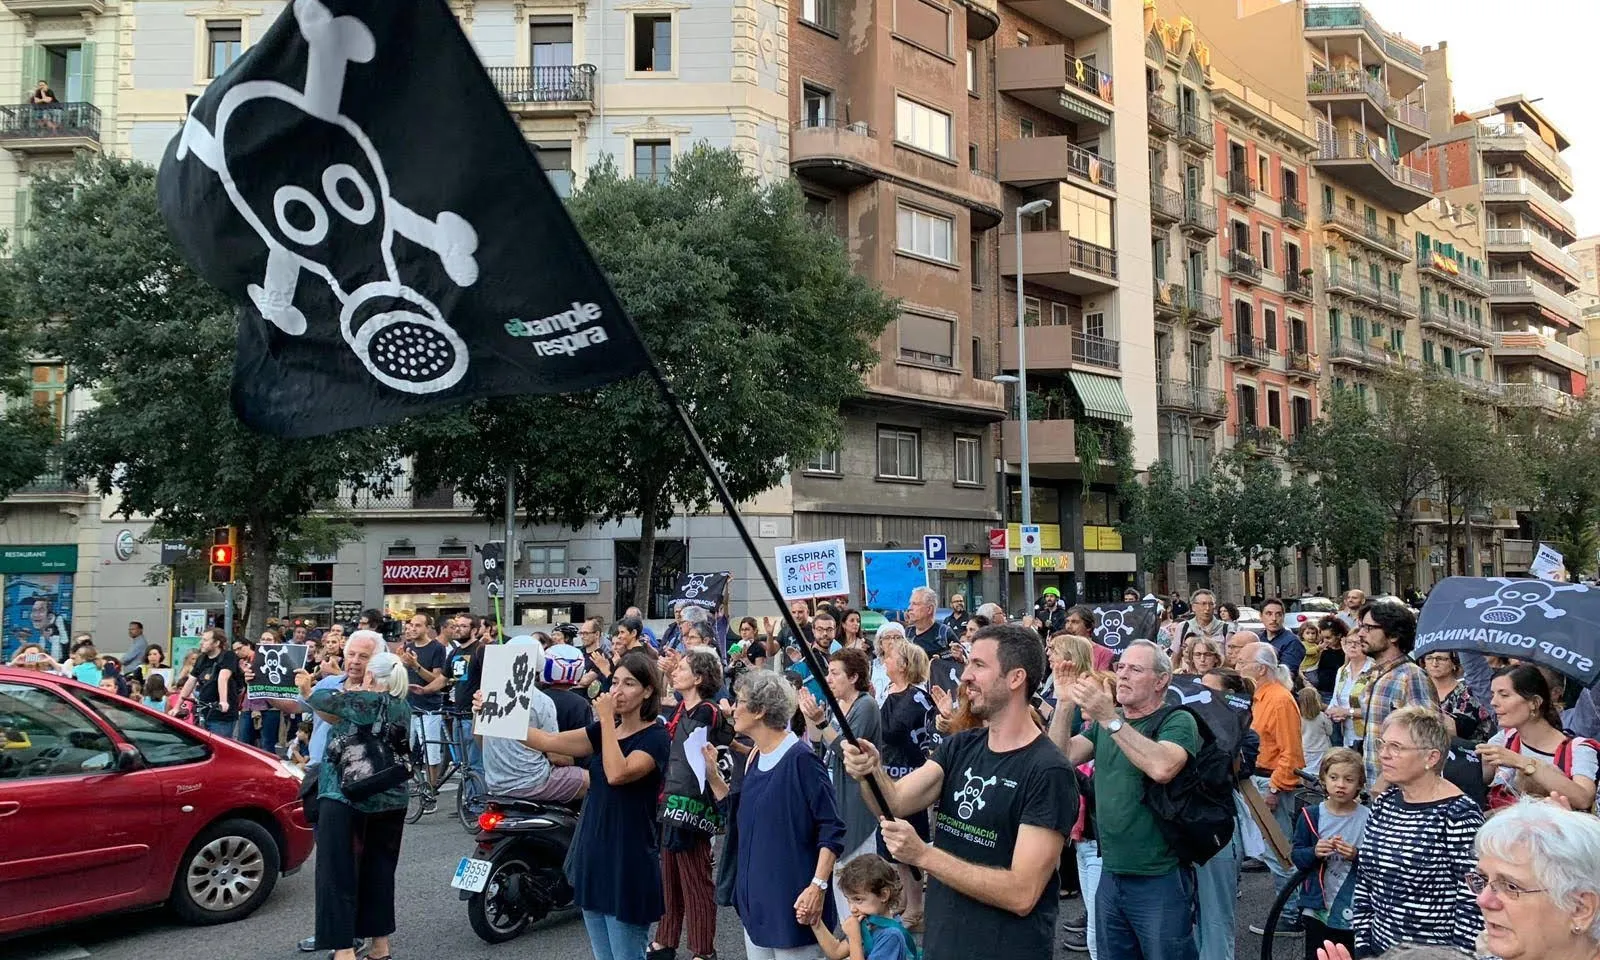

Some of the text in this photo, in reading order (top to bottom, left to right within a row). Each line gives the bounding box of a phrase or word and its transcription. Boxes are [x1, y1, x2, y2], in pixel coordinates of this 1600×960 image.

[532, 326, 608, 356] respira
[928, 538, 942, 558] P
[785, 549, 835, 564] RESPIRAR
[1015, 556, 1057, 568] OCINA
[384, 565, 449, 579] XURRERIA
[799, 561, 824, 573] AIRE
[513, 578, 588, 588] ERRUQUERIA
[803, 571, 826, 583] NET
[799, 584, 811, 593] UN
[814, 581, 838, 591] DRET
[883, 766, 908, 777] TOP
[667, 794, 704, 814] STOP
[663, 807, 698, 826] MENYS
[946, 817, 998, 841] CONTAMINACIÓ!
[974, 836, 996, 848] SALUT!
[464, 860, 488, 876] 9559
[459, 874, 478, 888] KGP
